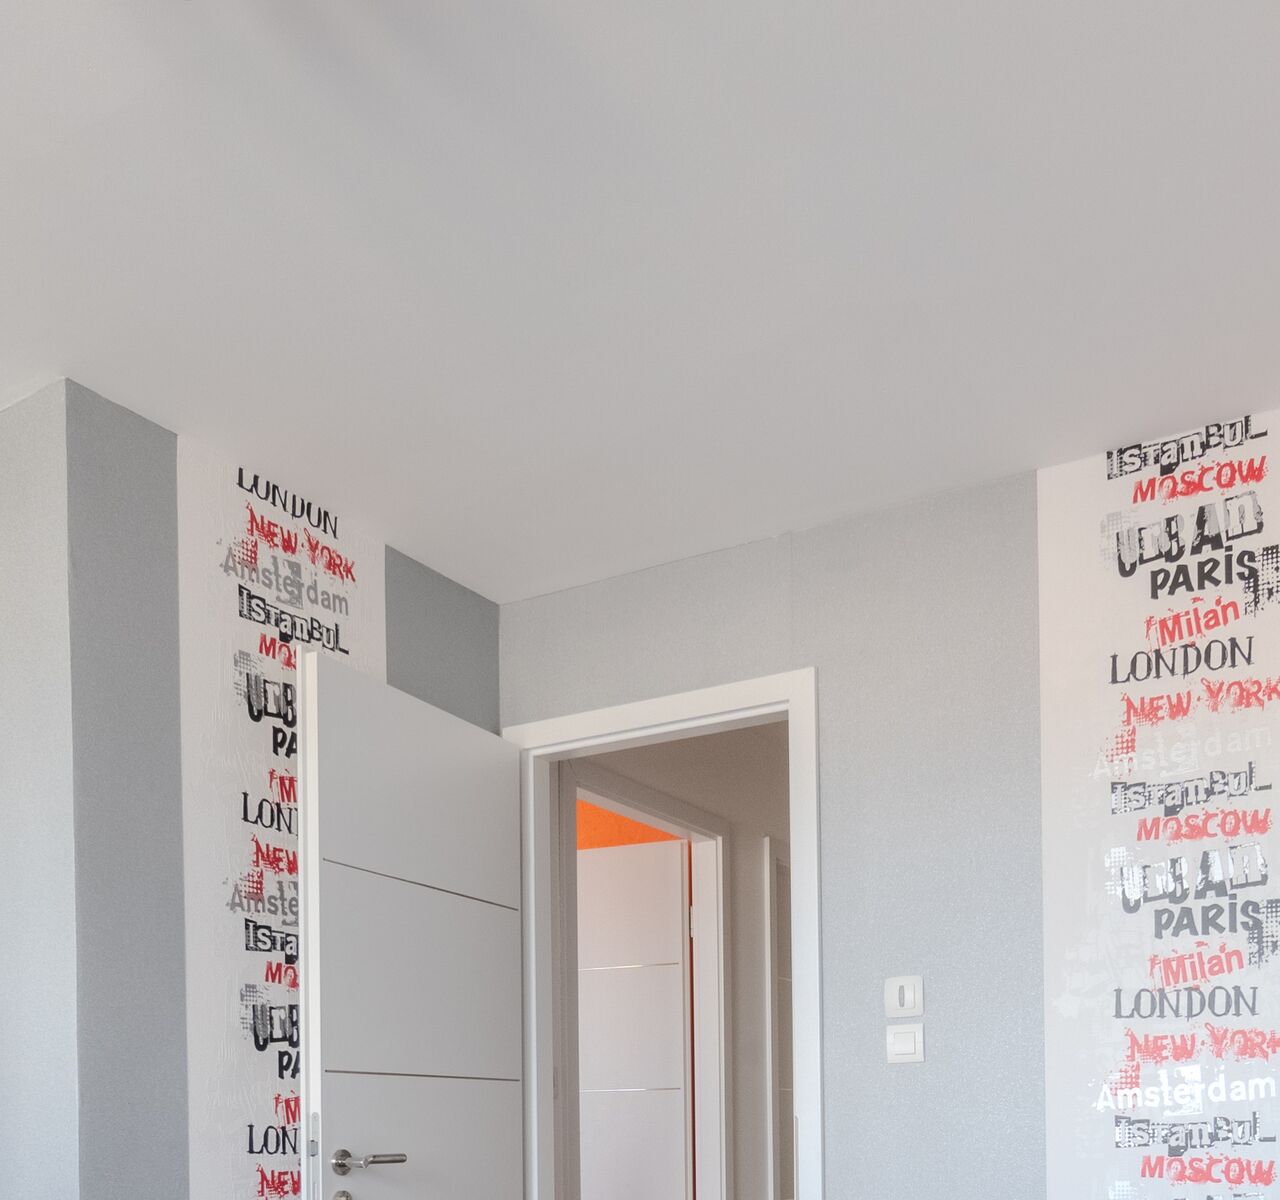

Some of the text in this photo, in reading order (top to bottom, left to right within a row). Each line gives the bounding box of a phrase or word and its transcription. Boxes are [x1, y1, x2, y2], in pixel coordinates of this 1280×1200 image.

[1132, 456, 1267, 504] MOSCOW
[222, 551, 349, 616] Amsterdam
[1156, 597, 1240, 648] Milan
[1109, 636, 1254, 685] LONDON
[241, 792, 298, 836] LON
[1137, 808, 1273, 842] MOSCOW
[1160, 942, 1244, 989] Milan
[1113, 985, 1259, 1020] LONDON
[1094, 1065, 1276, 1115] Amsterdam
[1141, 1154, 1276, 1186] MOSCOW
